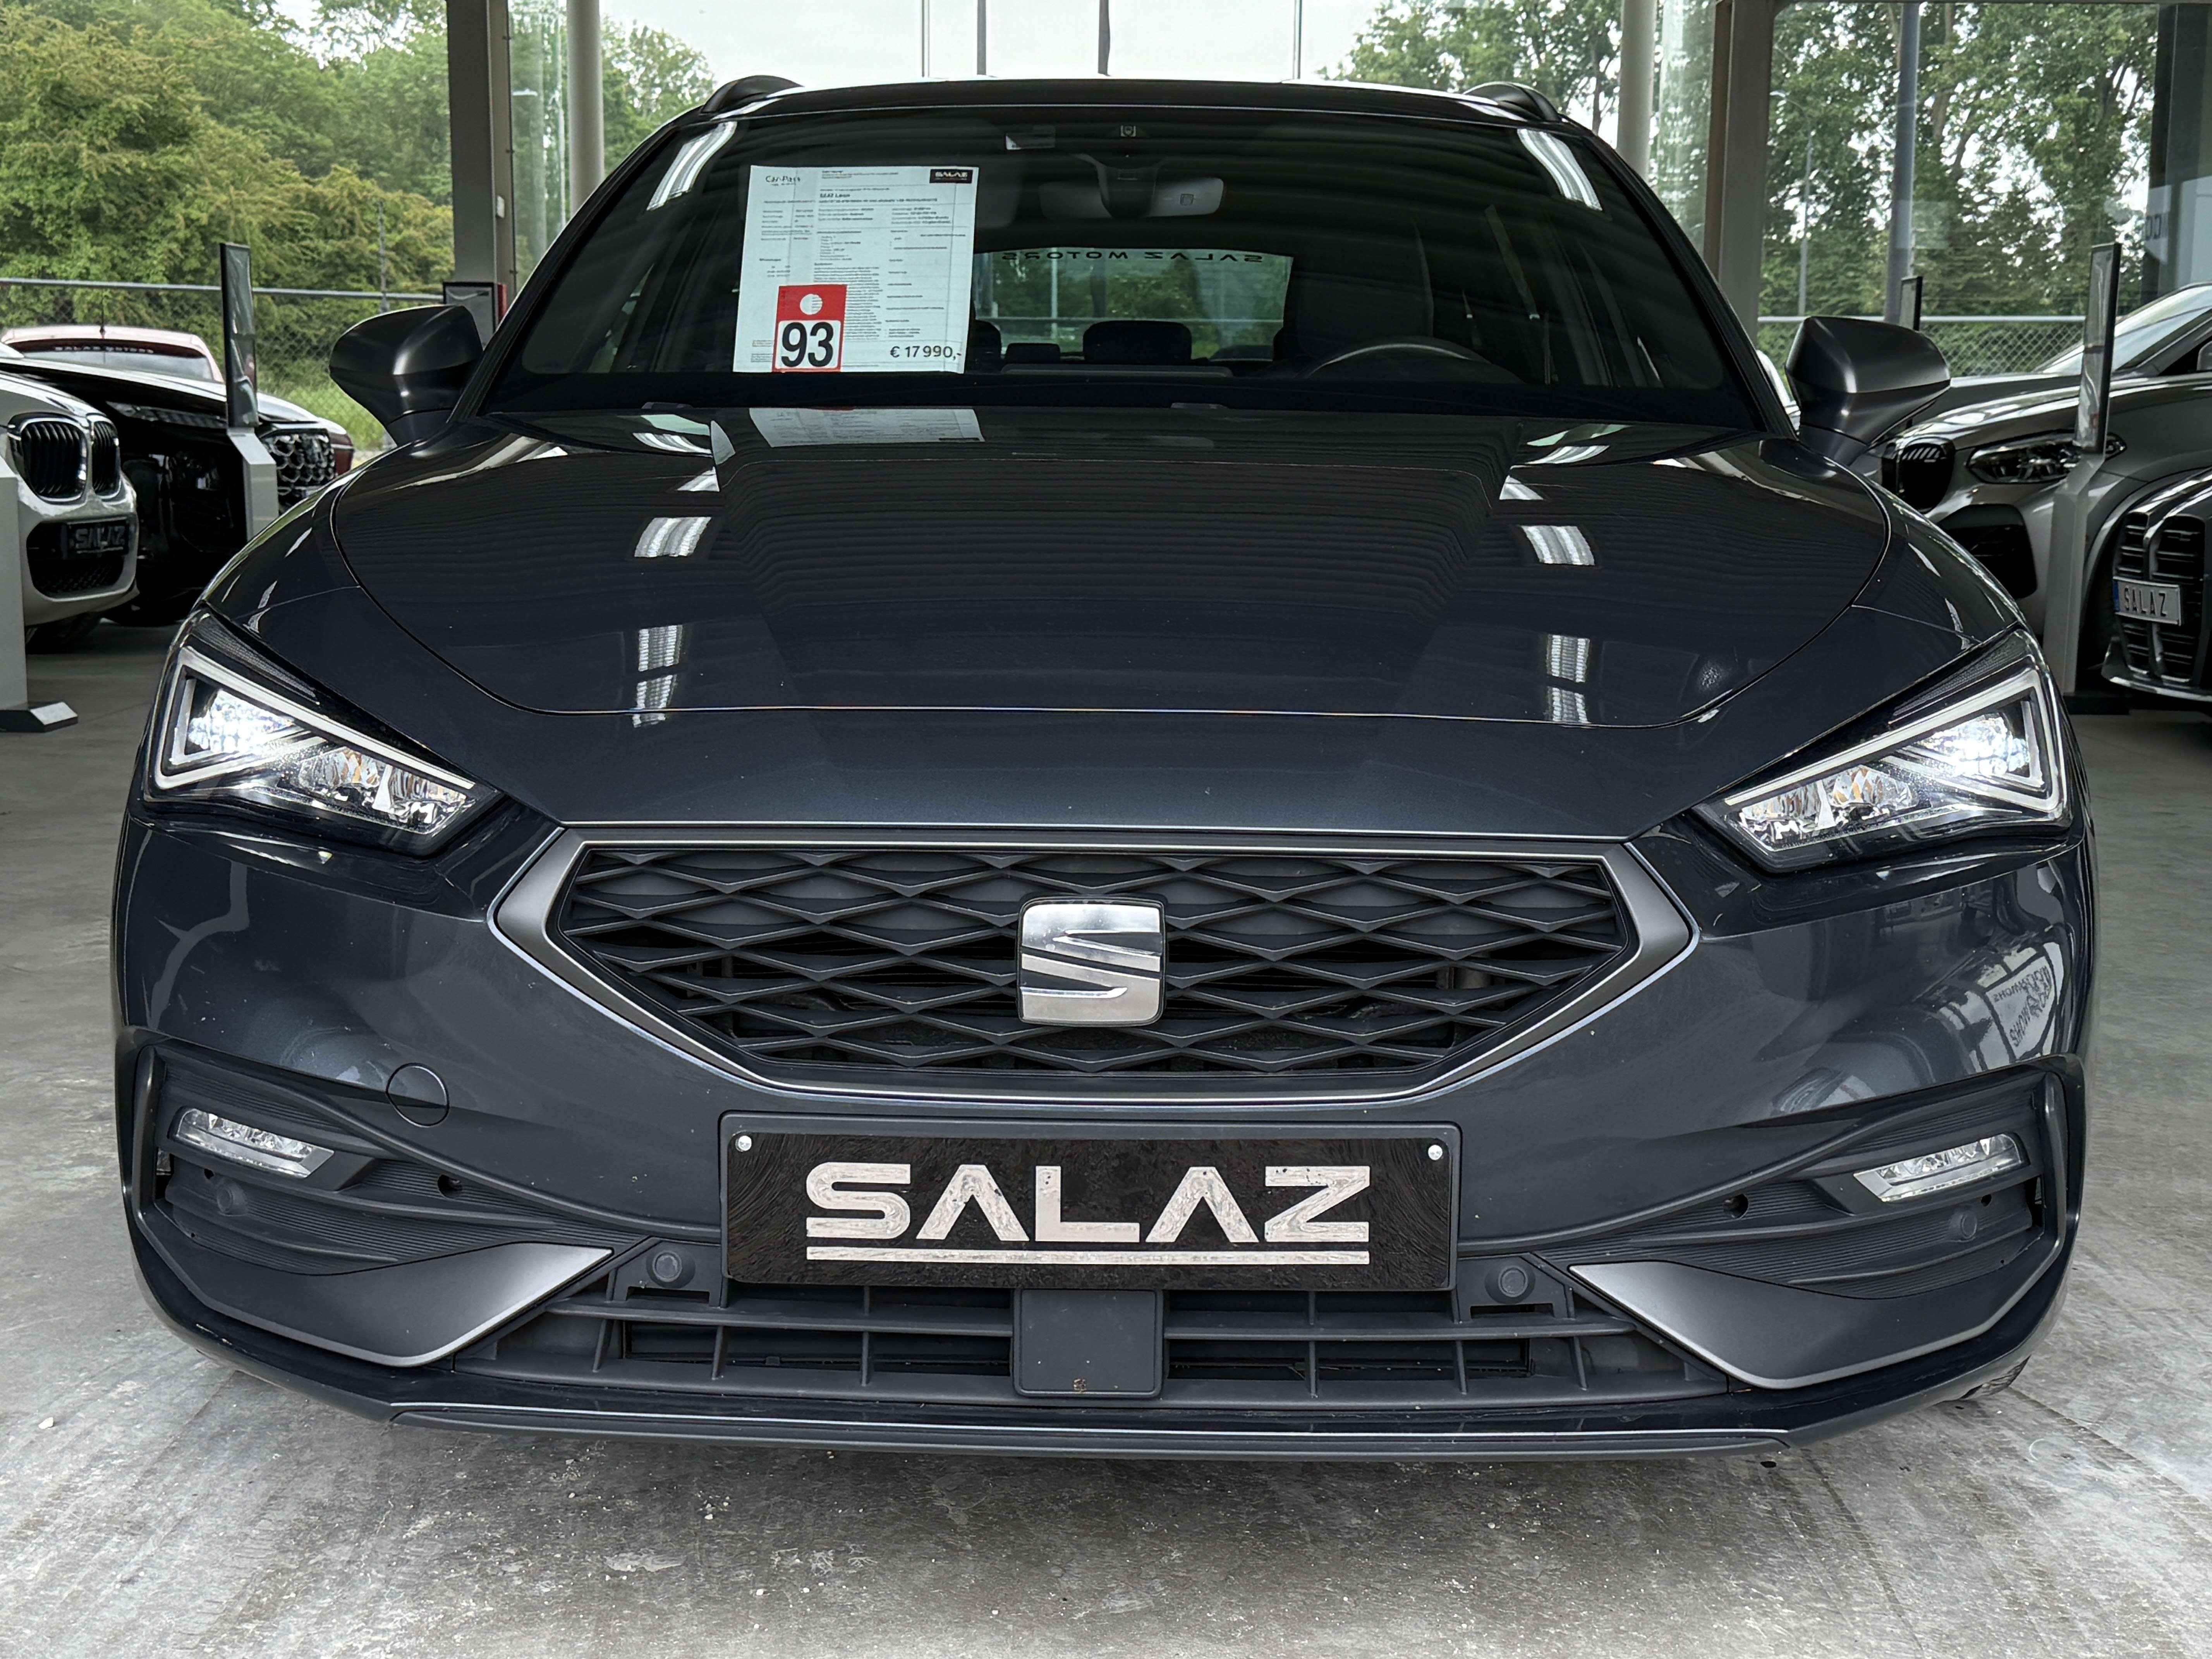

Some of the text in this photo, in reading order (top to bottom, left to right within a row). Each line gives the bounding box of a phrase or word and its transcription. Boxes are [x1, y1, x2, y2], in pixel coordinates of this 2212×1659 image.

[781, 322, 834, 367] 93
[890, 346, 900, 357] €
[2124, 587, 2166, 617] SALAZ
[806, 1163, 1370, 1243] SALAZ
